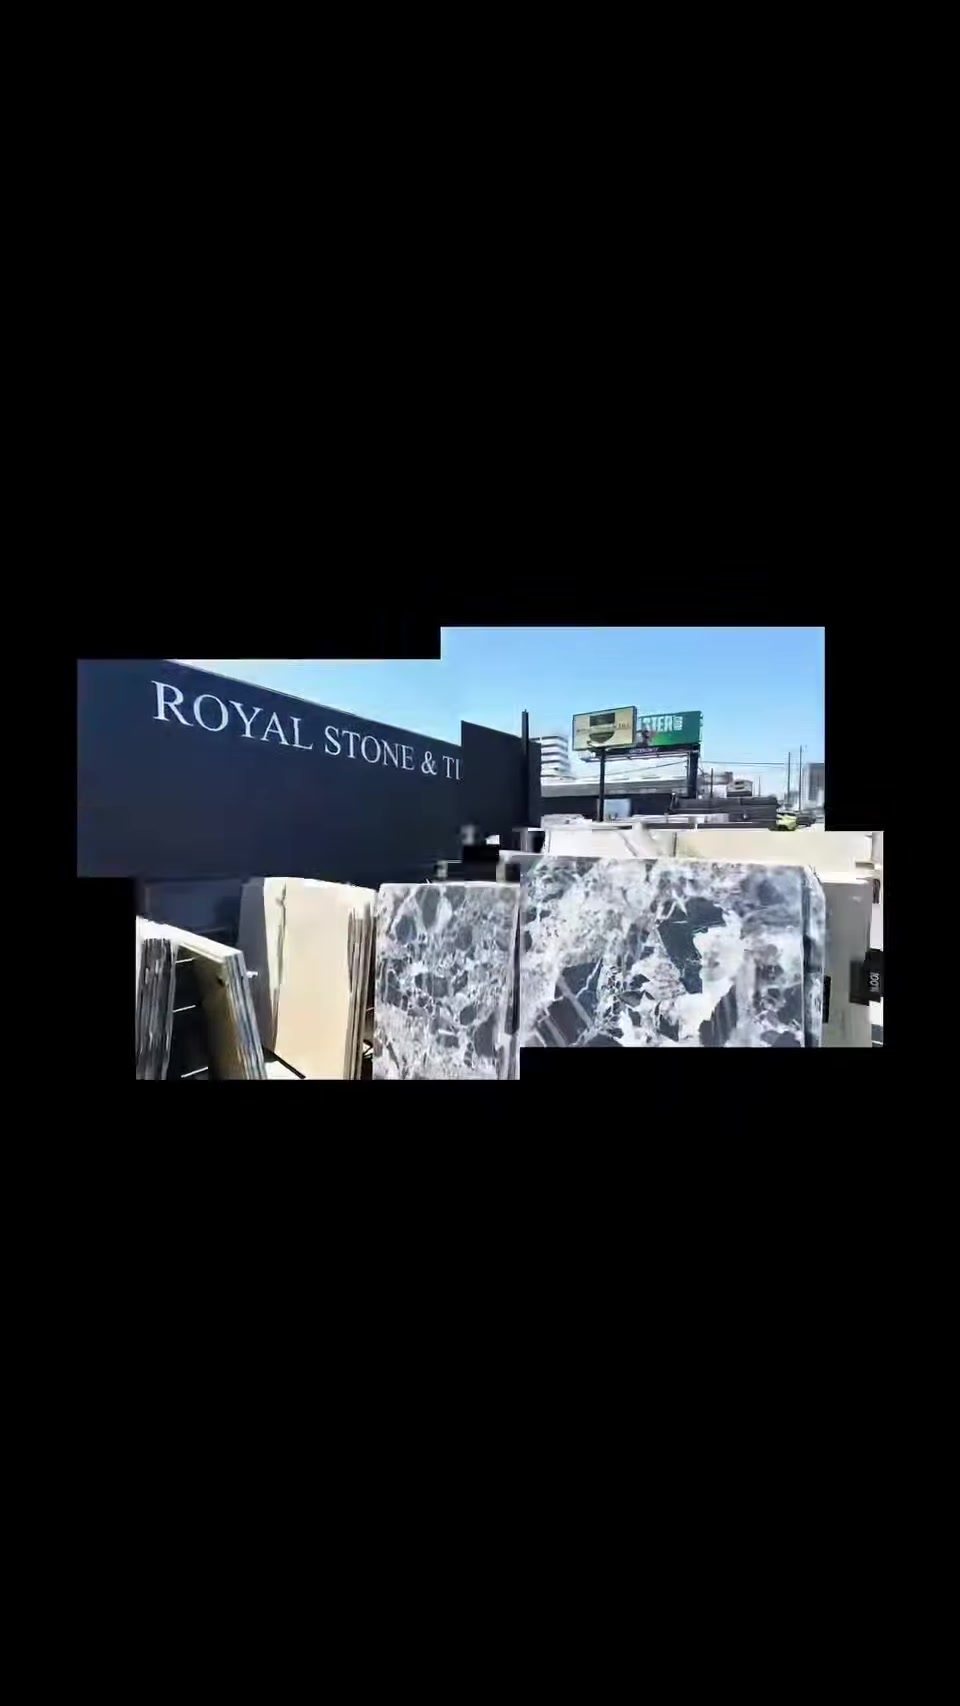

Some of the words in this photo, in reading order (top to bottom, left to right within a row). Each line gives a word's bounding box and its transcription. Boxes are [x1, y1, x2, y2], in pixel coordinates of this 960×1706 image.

[151, 680, 313, 750] ROYAL
[324, 725, 415, 771] STONE
[421, 750, 438, 775] &
[639, 715, 673, 733] STER
